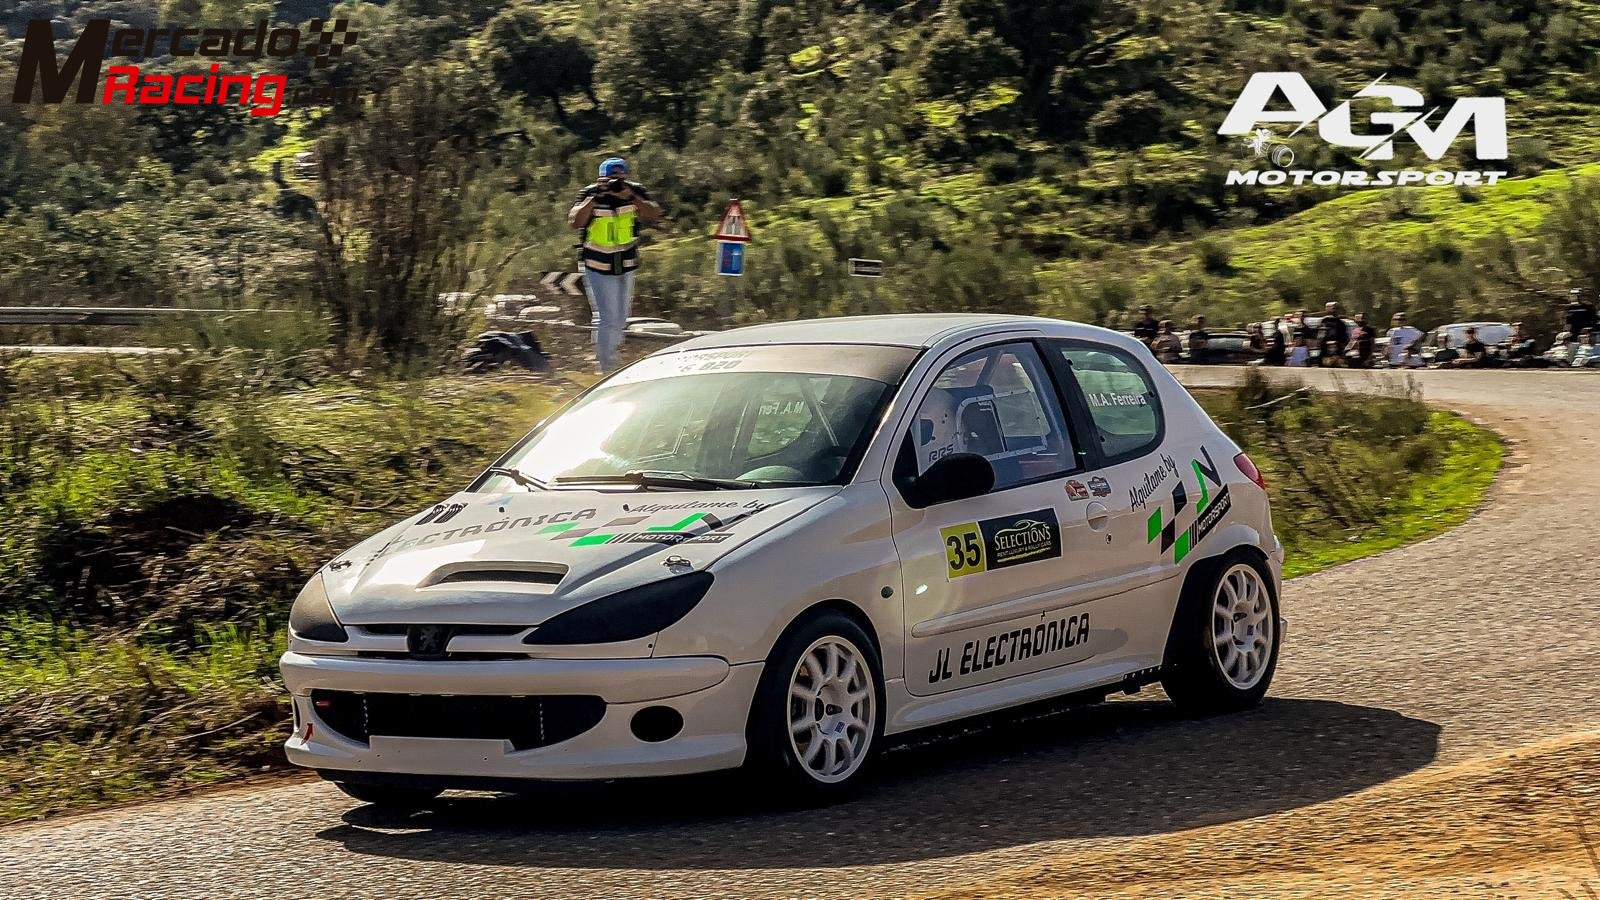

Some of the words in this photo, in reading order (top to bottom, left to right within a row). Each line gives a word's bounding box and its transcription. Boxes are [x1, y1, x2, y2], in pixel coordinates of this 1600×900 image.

[1089, 393, 1112, 407] M.A.
[1110, 392, 1147, 405] Ferreira
[1160, 453, 1180, 478] by
[1199, 493, 1231, 532] MOTORSPORT
[946, 532, 982, 571] 35
[995, 525, 1051, 551] SELECTIONS
[928, 647, 953, 684] JL
